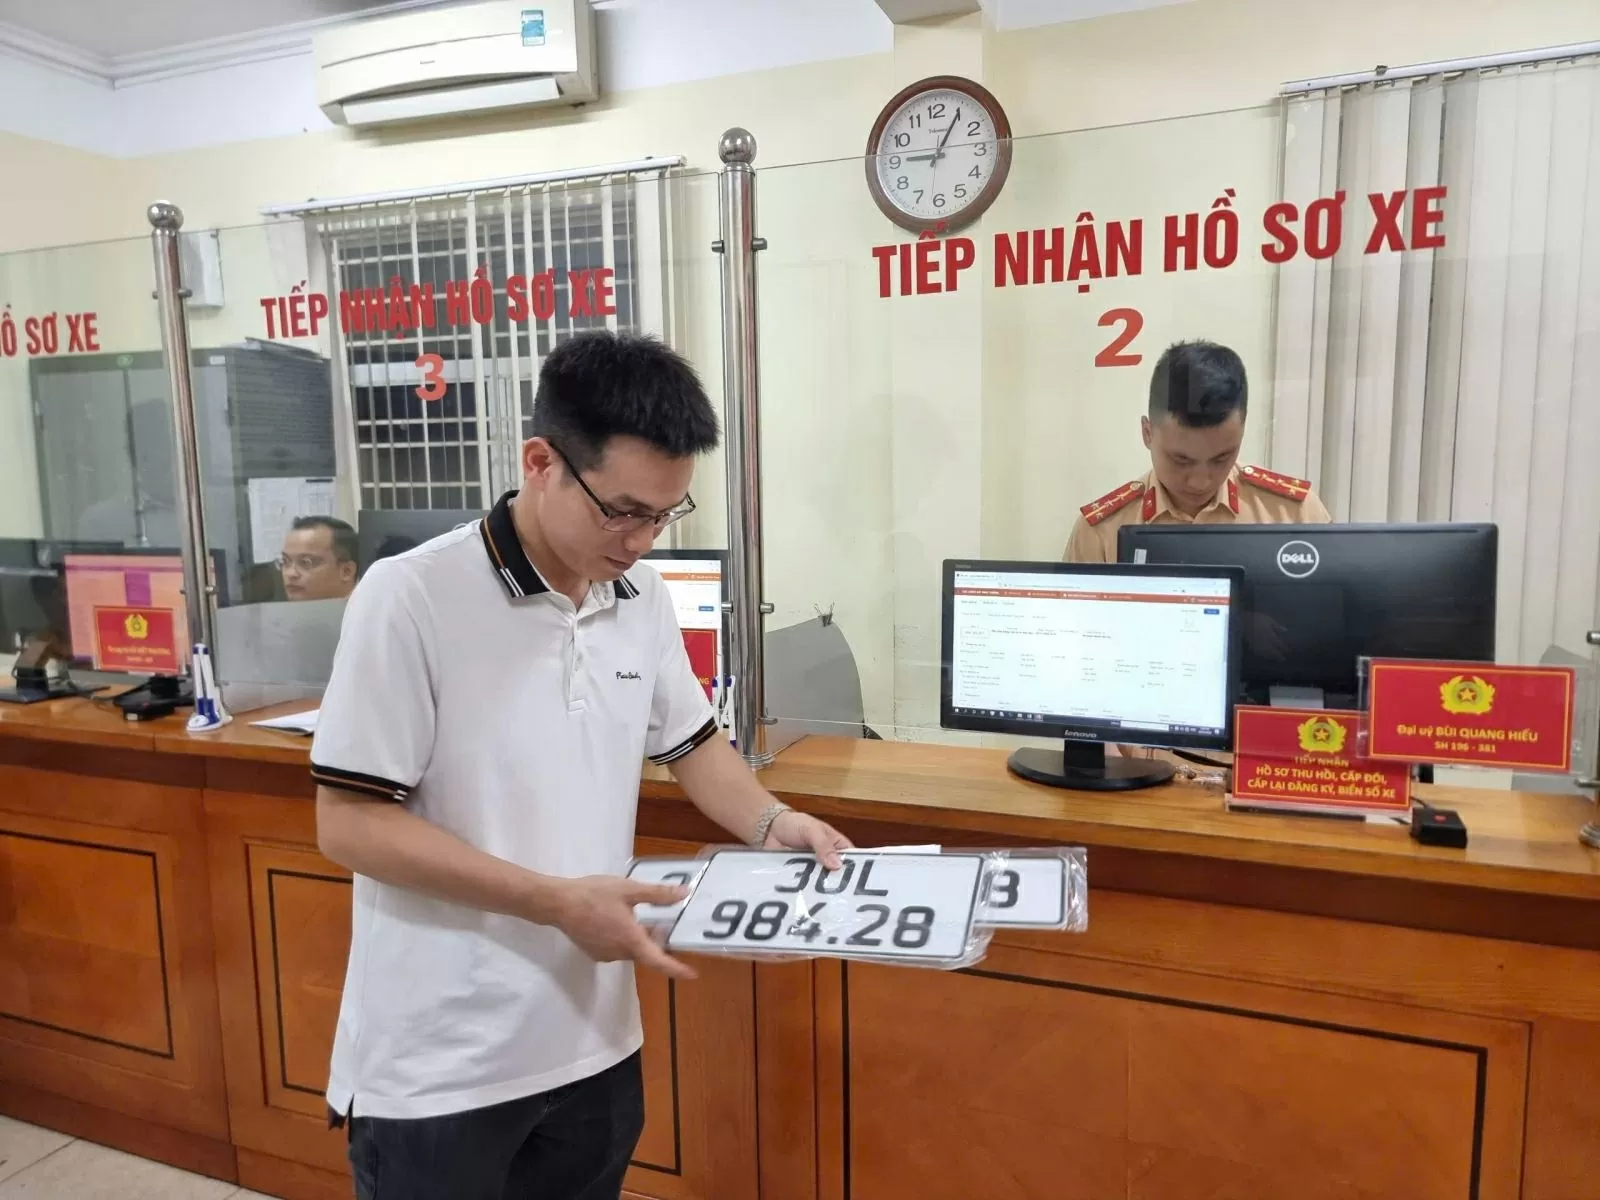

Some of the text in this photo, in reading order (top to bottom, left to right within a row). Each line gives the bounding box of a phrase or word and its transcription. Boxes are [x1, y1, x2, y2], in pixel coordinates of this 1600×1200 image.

[928, 104, 945, 119] 12
[909, 114, 921, 128] 11
[967, 122, 981, 136] 2
[894, 133, 910, 148] 10
[974, 142, 986, 156] 3
[889, 156, 901, 169] 9
[968, 165, 981, 178] 4
[897, 176, 909, 190] 8
[913, 190, 924, 204] 7
[954, 184, 966, 198] 5
[933, 194, 945, 207] 6
[872, 186, 1447, 297] TIẾP NHẬN HỒ SƠ XE
[260, 280, 328, 339] TIẾP
[340, 276, 435, 340] NHẬN
[507, 268, 556, 322] SƠ
[568, 268, 616, 318] XE
[25, 312, 58, 354] SƠ
[66, 312, 100, 352] XE
[1095, 308, 1144, 367] 2
[415, 353, 446, 400] 3
[1282, 553, 1314, 564] DELL
[1064, 730, 1096, 738] lenovo
[1397, 724, 1416, 736] Đại
[1460, 728, 1505, 740] QUANG
[1292, 768, 1313, 778] THU
[1382, 788, 1396, 798] XE
[774, 858, 888, 896] 30L
[703, 900, 935, 948] 984.28
